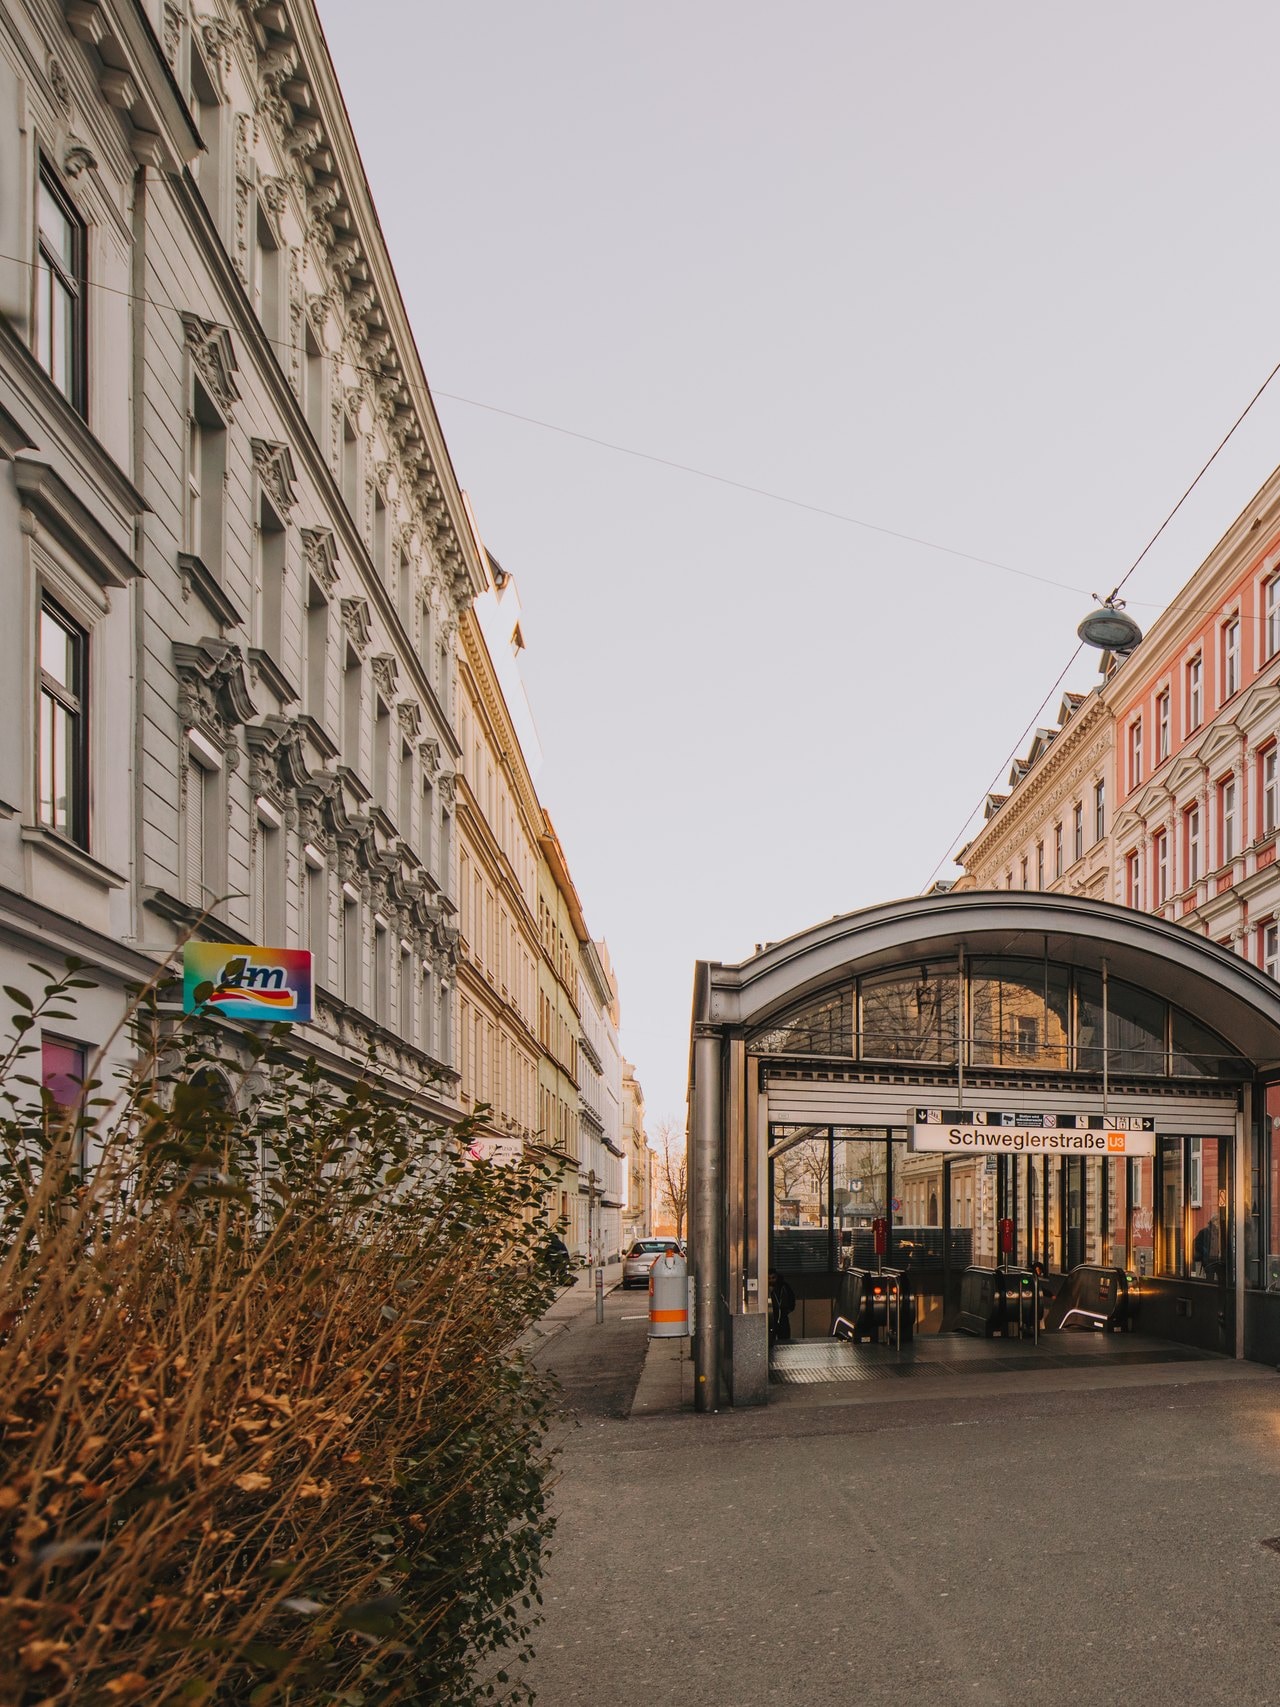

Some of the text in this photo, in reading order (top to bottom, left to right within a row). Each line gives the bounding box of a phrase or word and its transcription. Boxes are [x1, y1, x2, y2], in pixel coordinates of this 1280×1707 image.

[220, 957, 284, 988] dm
[949, 1129, 1124, 1150] Schweglerstraße U3
